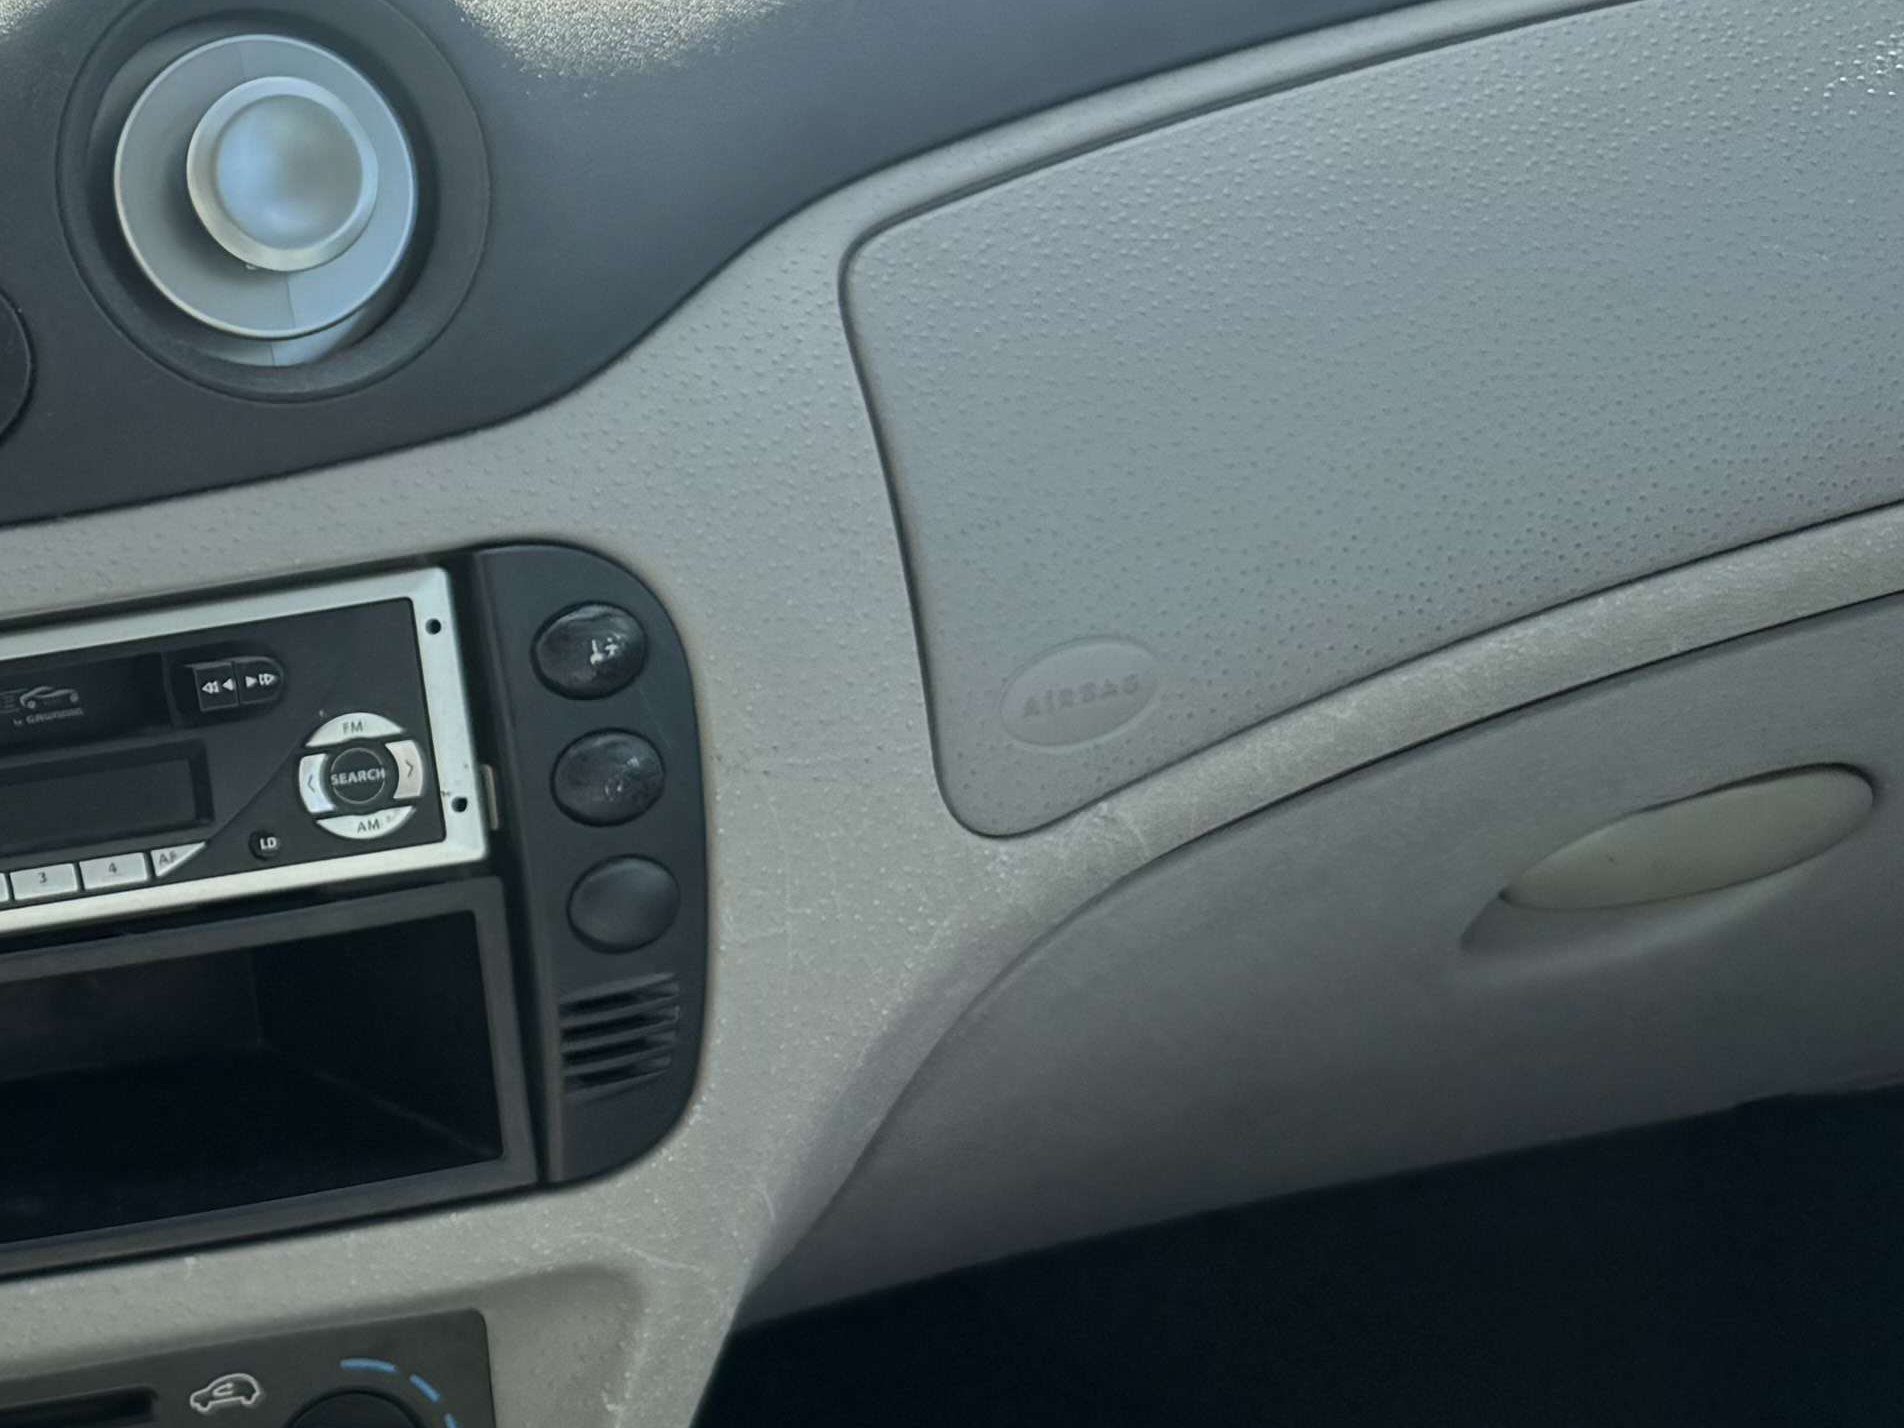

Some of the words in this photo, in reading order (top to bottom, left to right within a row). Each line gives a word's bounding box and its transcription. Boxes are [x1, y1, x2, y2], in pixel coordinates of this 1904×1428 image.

[343, 720, 364, 734] FM
[330, 767, 386, 787] SEARCH
[356, 820, 381, 834] AM
[259, 836, 277, 851] LD
[108, 862, 118, 874] 4
[37, 872, 48, 884] 3
